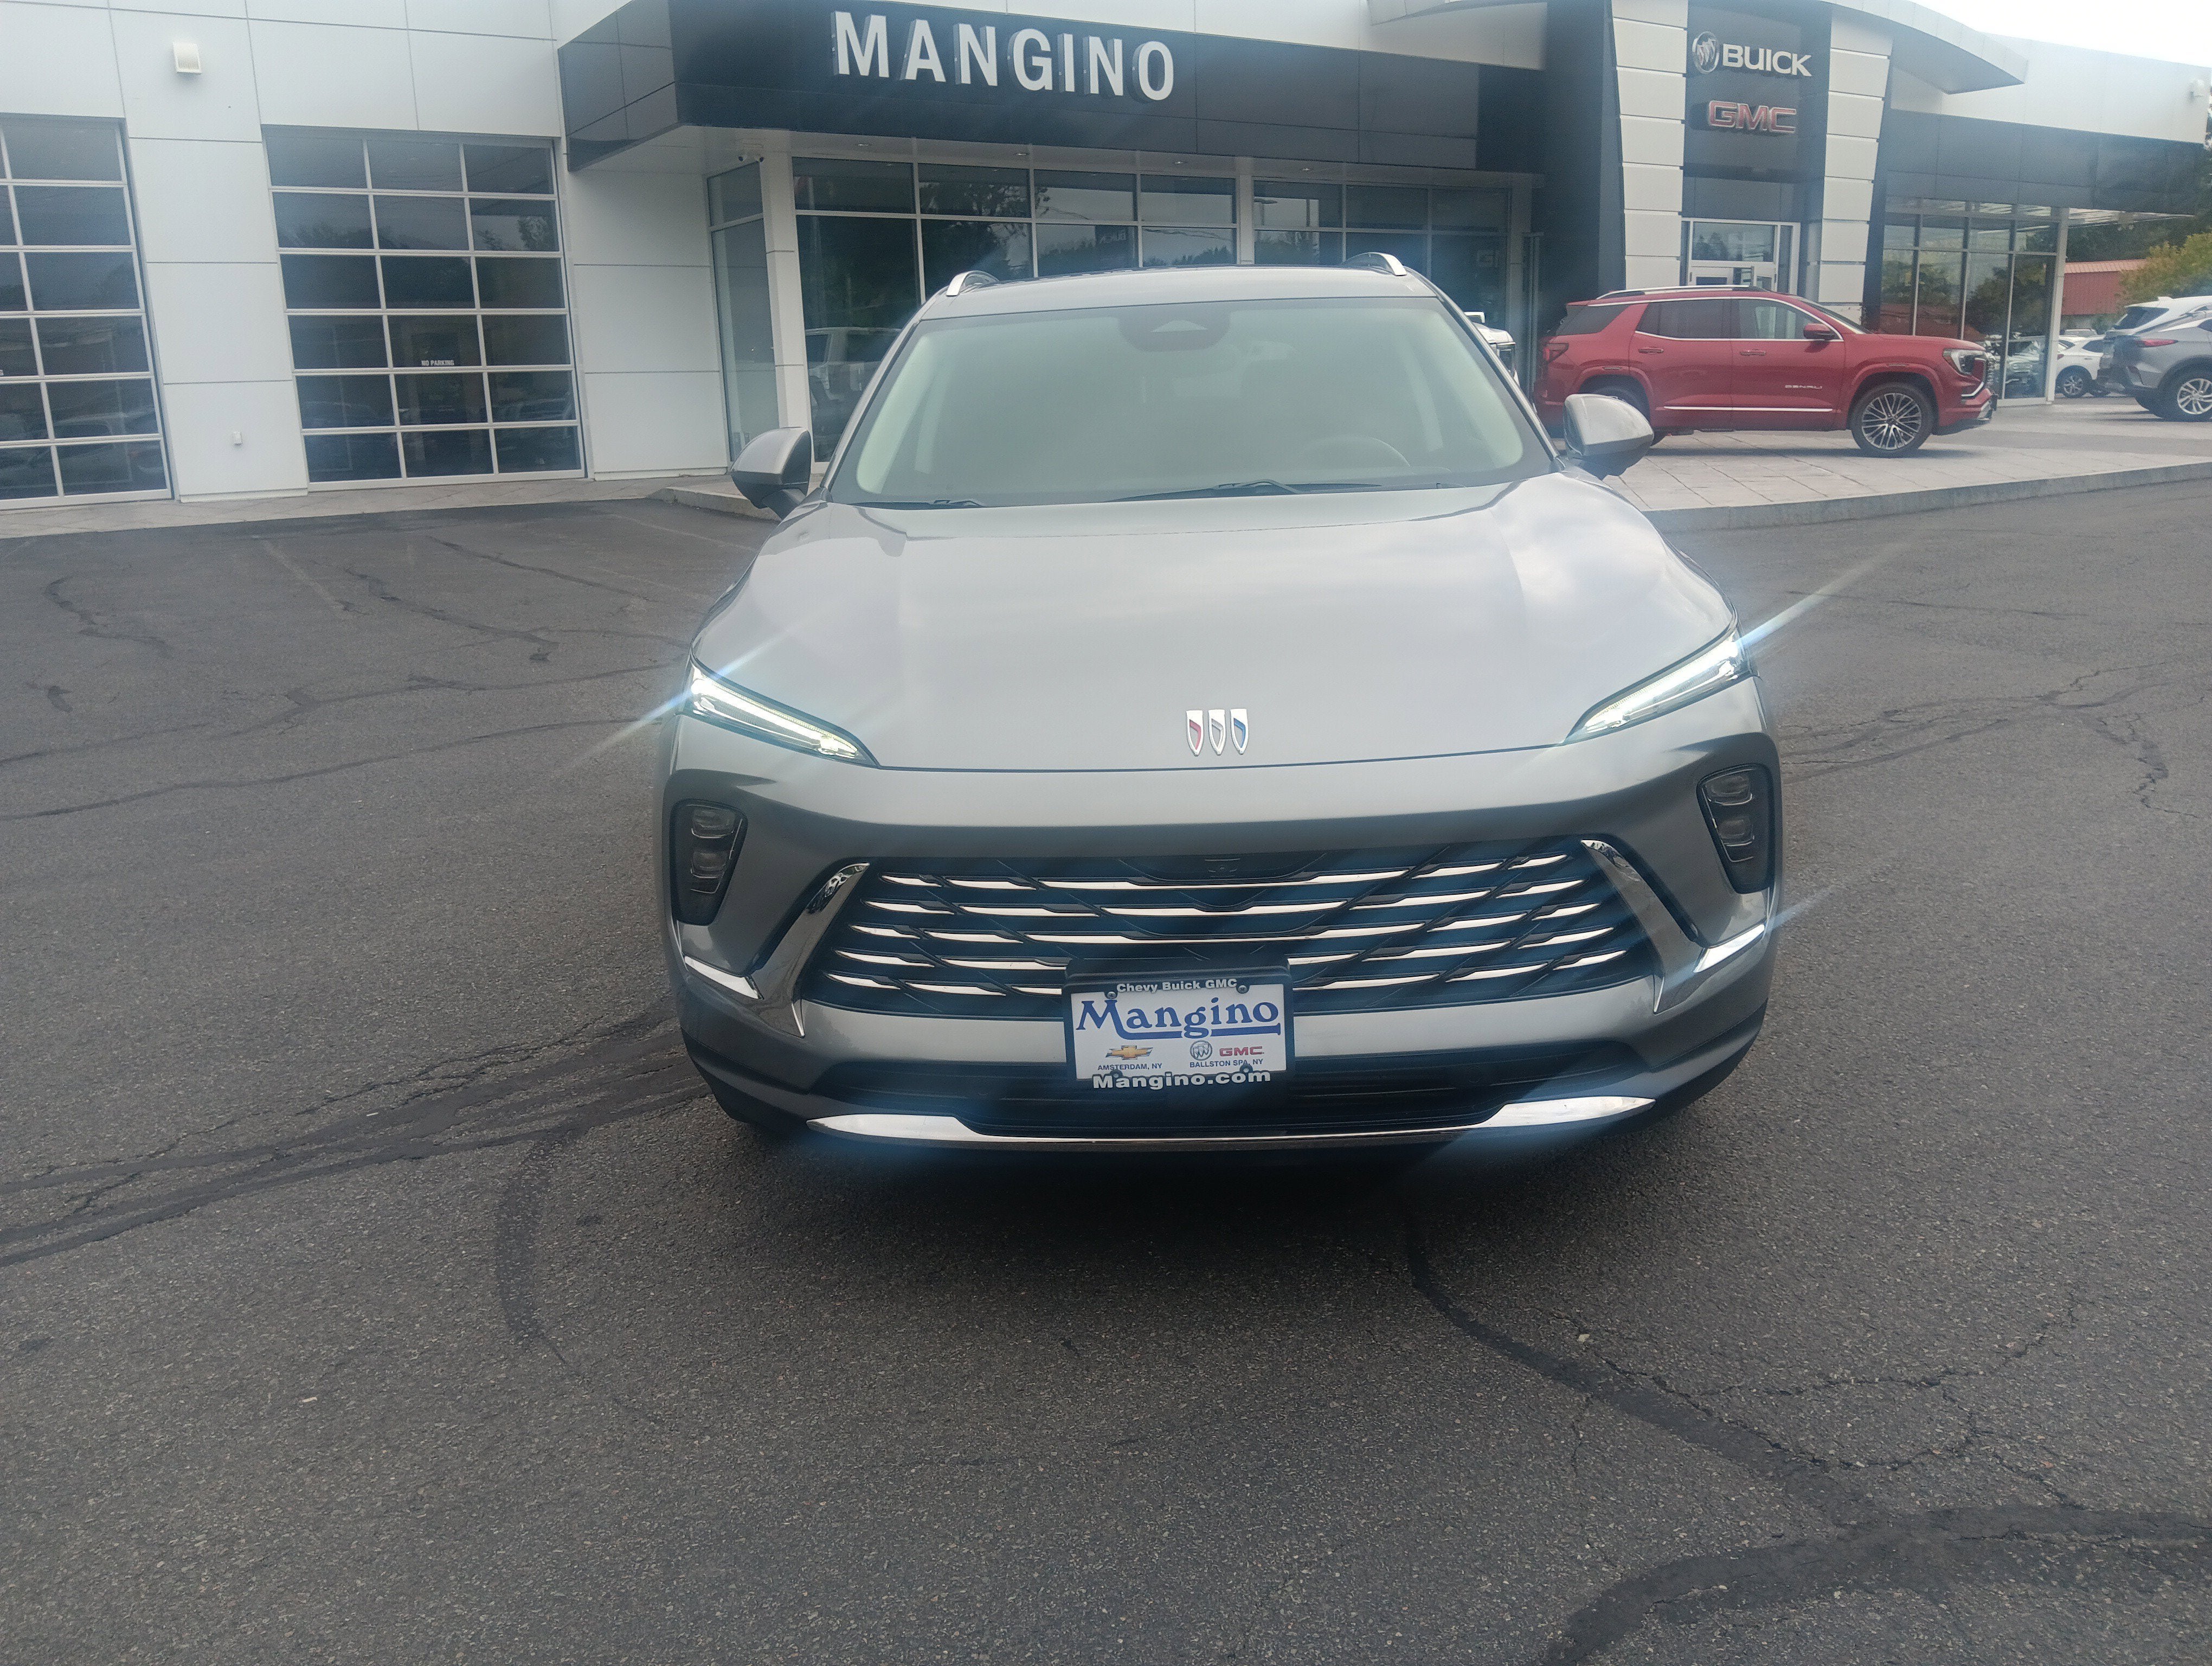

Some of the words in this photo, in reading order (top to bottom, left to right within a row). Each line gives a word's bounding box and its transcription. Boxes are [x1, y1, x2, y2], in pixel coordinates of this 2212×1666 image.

[831, 11, 1174, 100] MANGINO
[1722, 43, 1812, 77] BUICK
[1709, 100, 1797, 133] GMC
[1116, 983, 1158, 993] Chevy
[1162, 981, 1201, 991] Buick
[1205, 978, 1237, 989] GMC
[1076, 997, 1281, 1040] Mangino
[1219, 1046, 1264, 1056] GMC
[1092, 1071, 1271, 1090] Mangino.com
